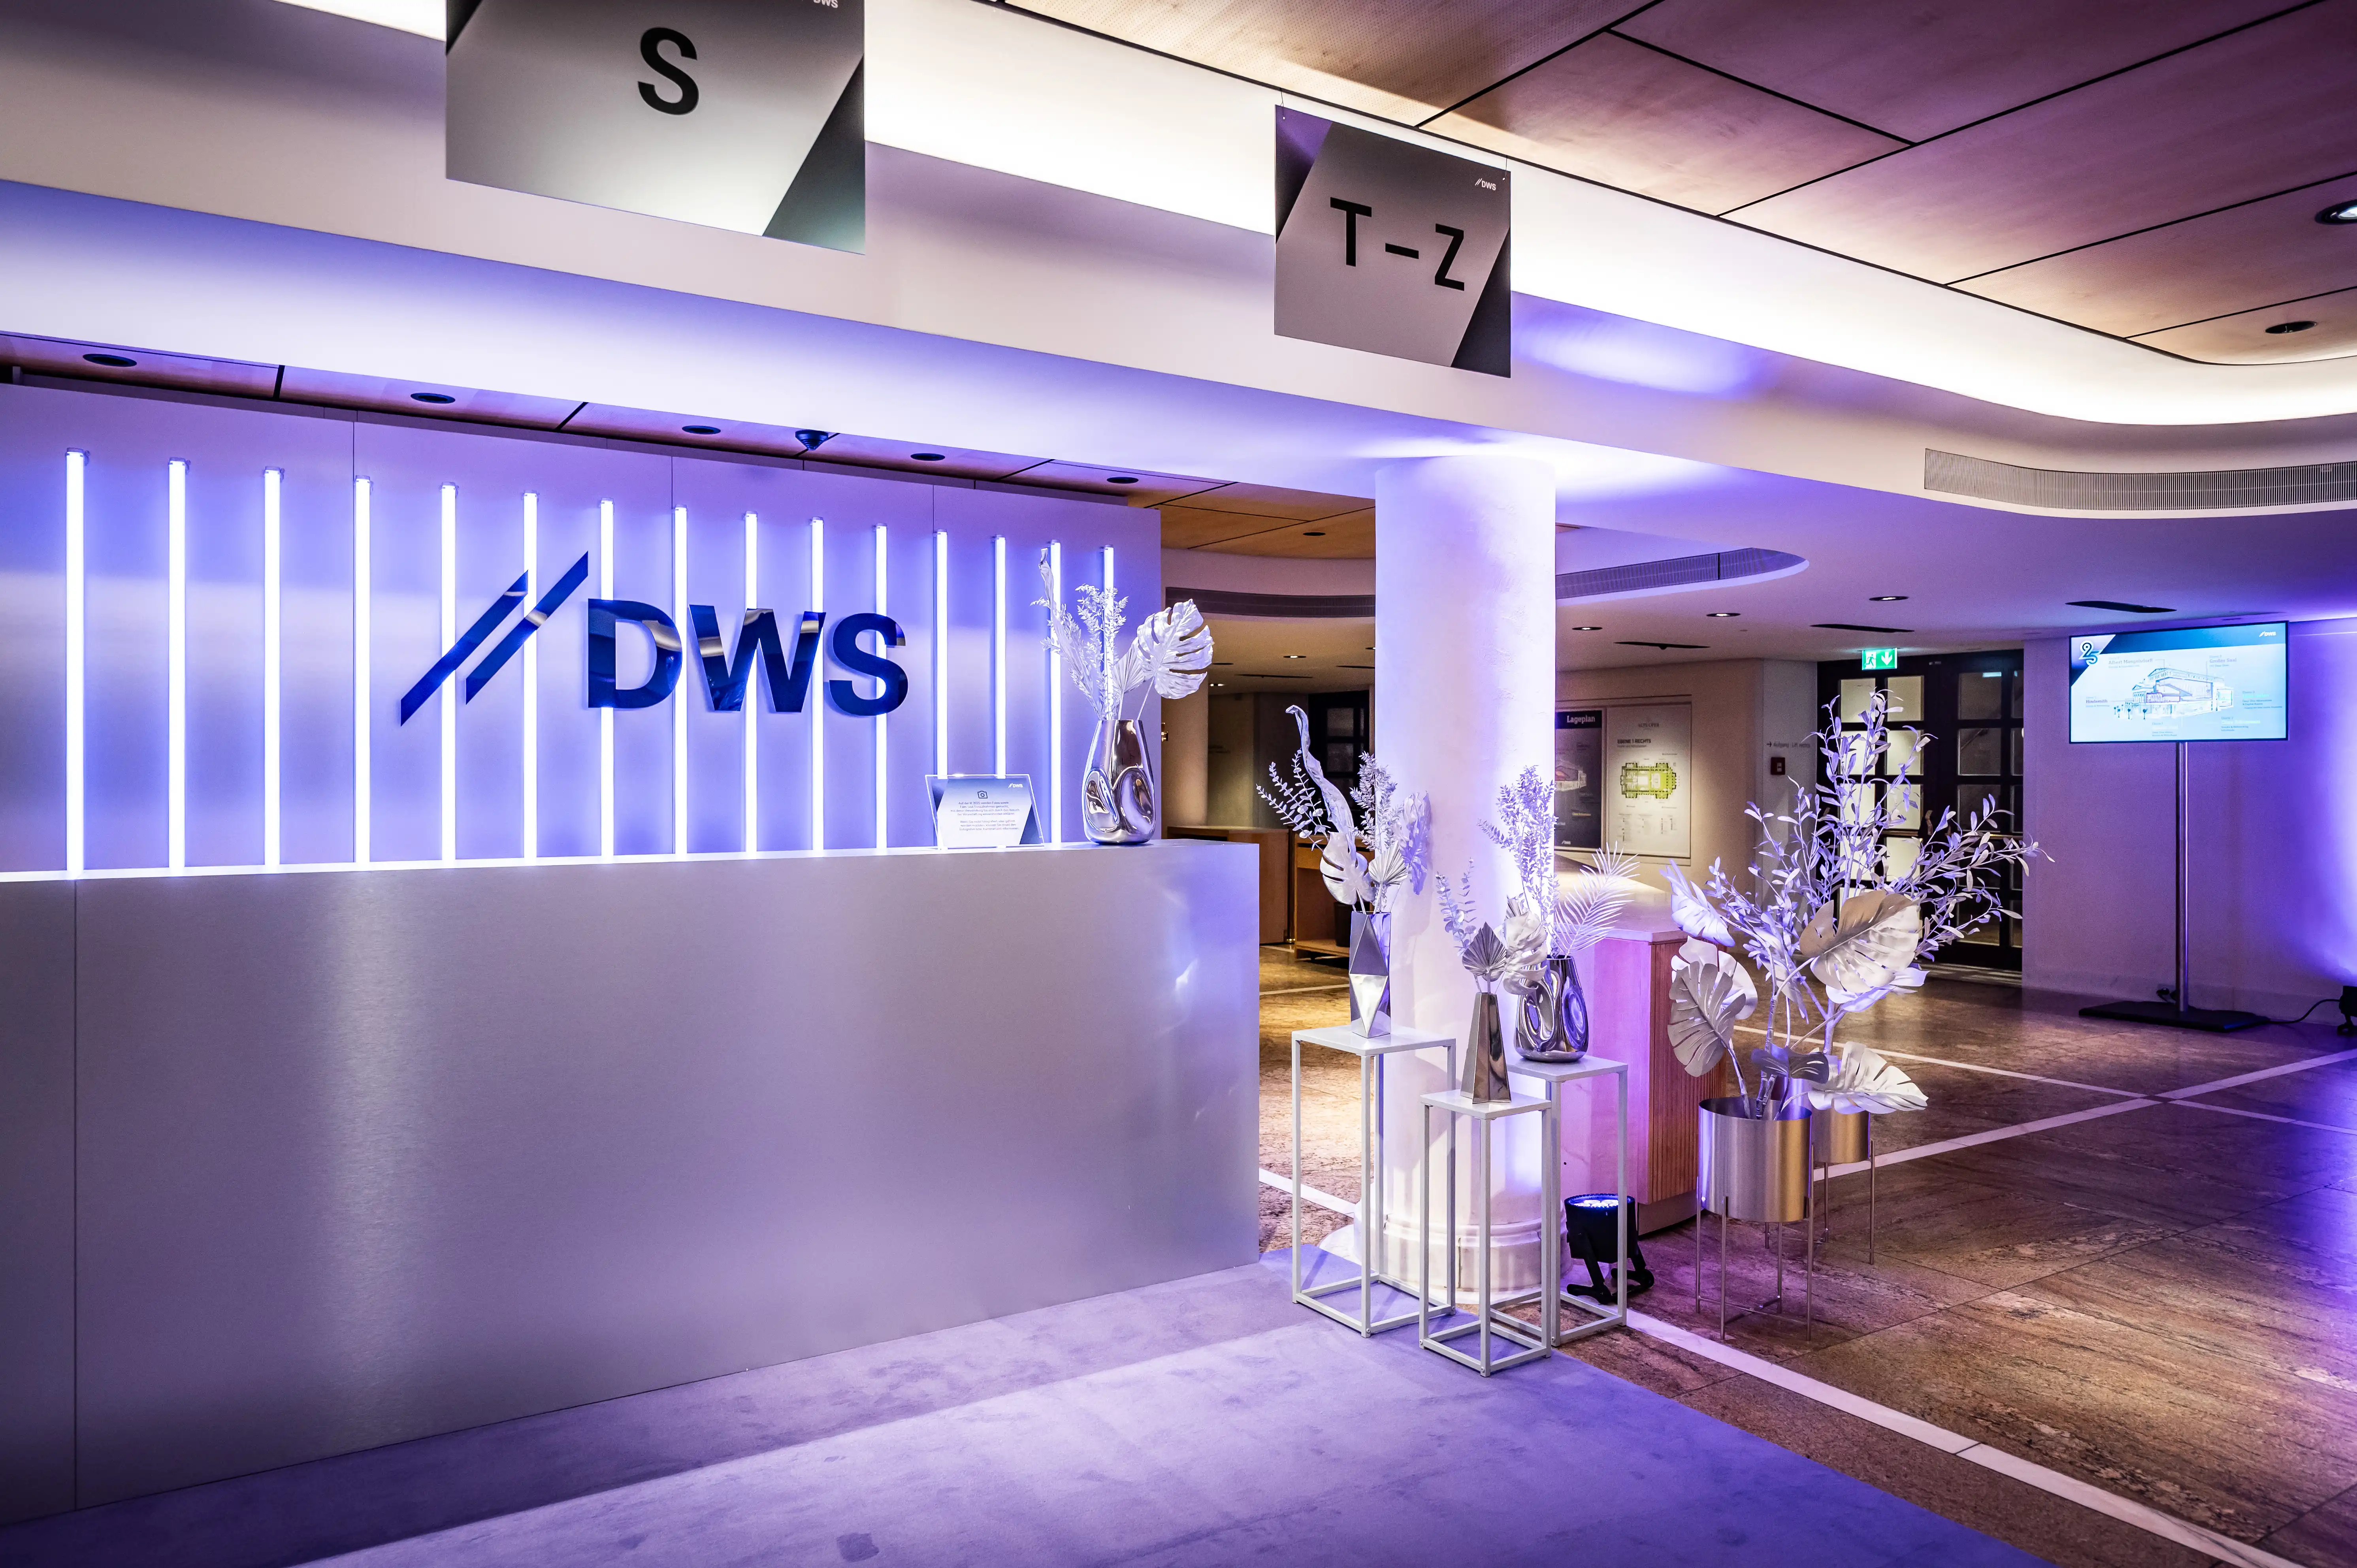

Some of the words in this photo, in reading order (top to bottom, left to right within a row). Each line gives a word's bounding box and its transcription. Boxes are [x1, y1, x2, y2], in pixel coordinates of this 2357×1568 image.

[638, 27, 699, 115] S
[1481, 180, 1496, 191] DWS
[588, 598, 908, 716] DWS
[1567, 714, 1596, 725] Lageplan
